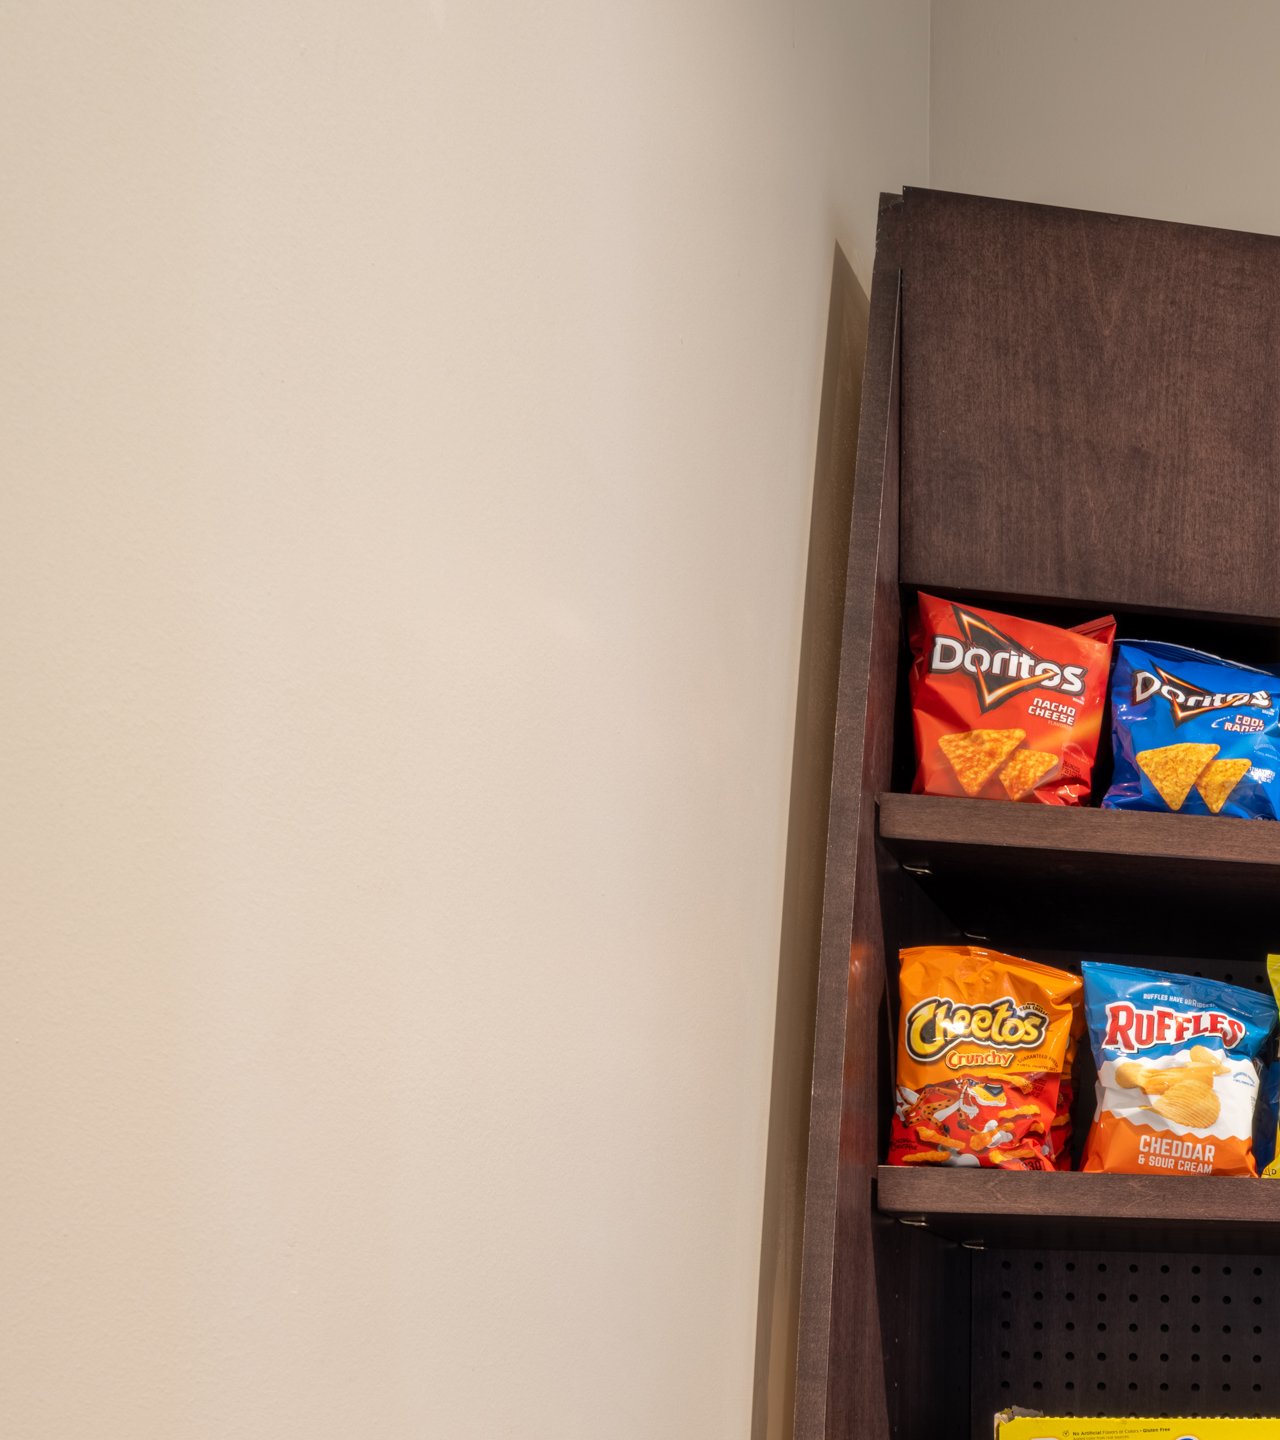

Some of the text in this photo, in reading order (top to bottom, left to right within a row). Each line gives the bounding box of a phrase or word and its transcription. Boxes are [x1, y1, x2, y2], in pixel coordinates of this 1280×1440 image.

[930, 635, 1087, 695] Doritos
[1133, 671, 1273, 709] Doritos
[1028, 706, 1075, 726] CHEESE
[1033, 697, 1076, 716] NACHO
[908, 998, 1048, 1059] Cheetos
[1104, 1002, 1246, 1053] RUFFLES
[946, 1051, 1014, 1069] Crunchy
[1139, 1135, 1216, 1162] CHEDDAR
[1138, 1153, 1213, 1175] & SOUR CREAM
